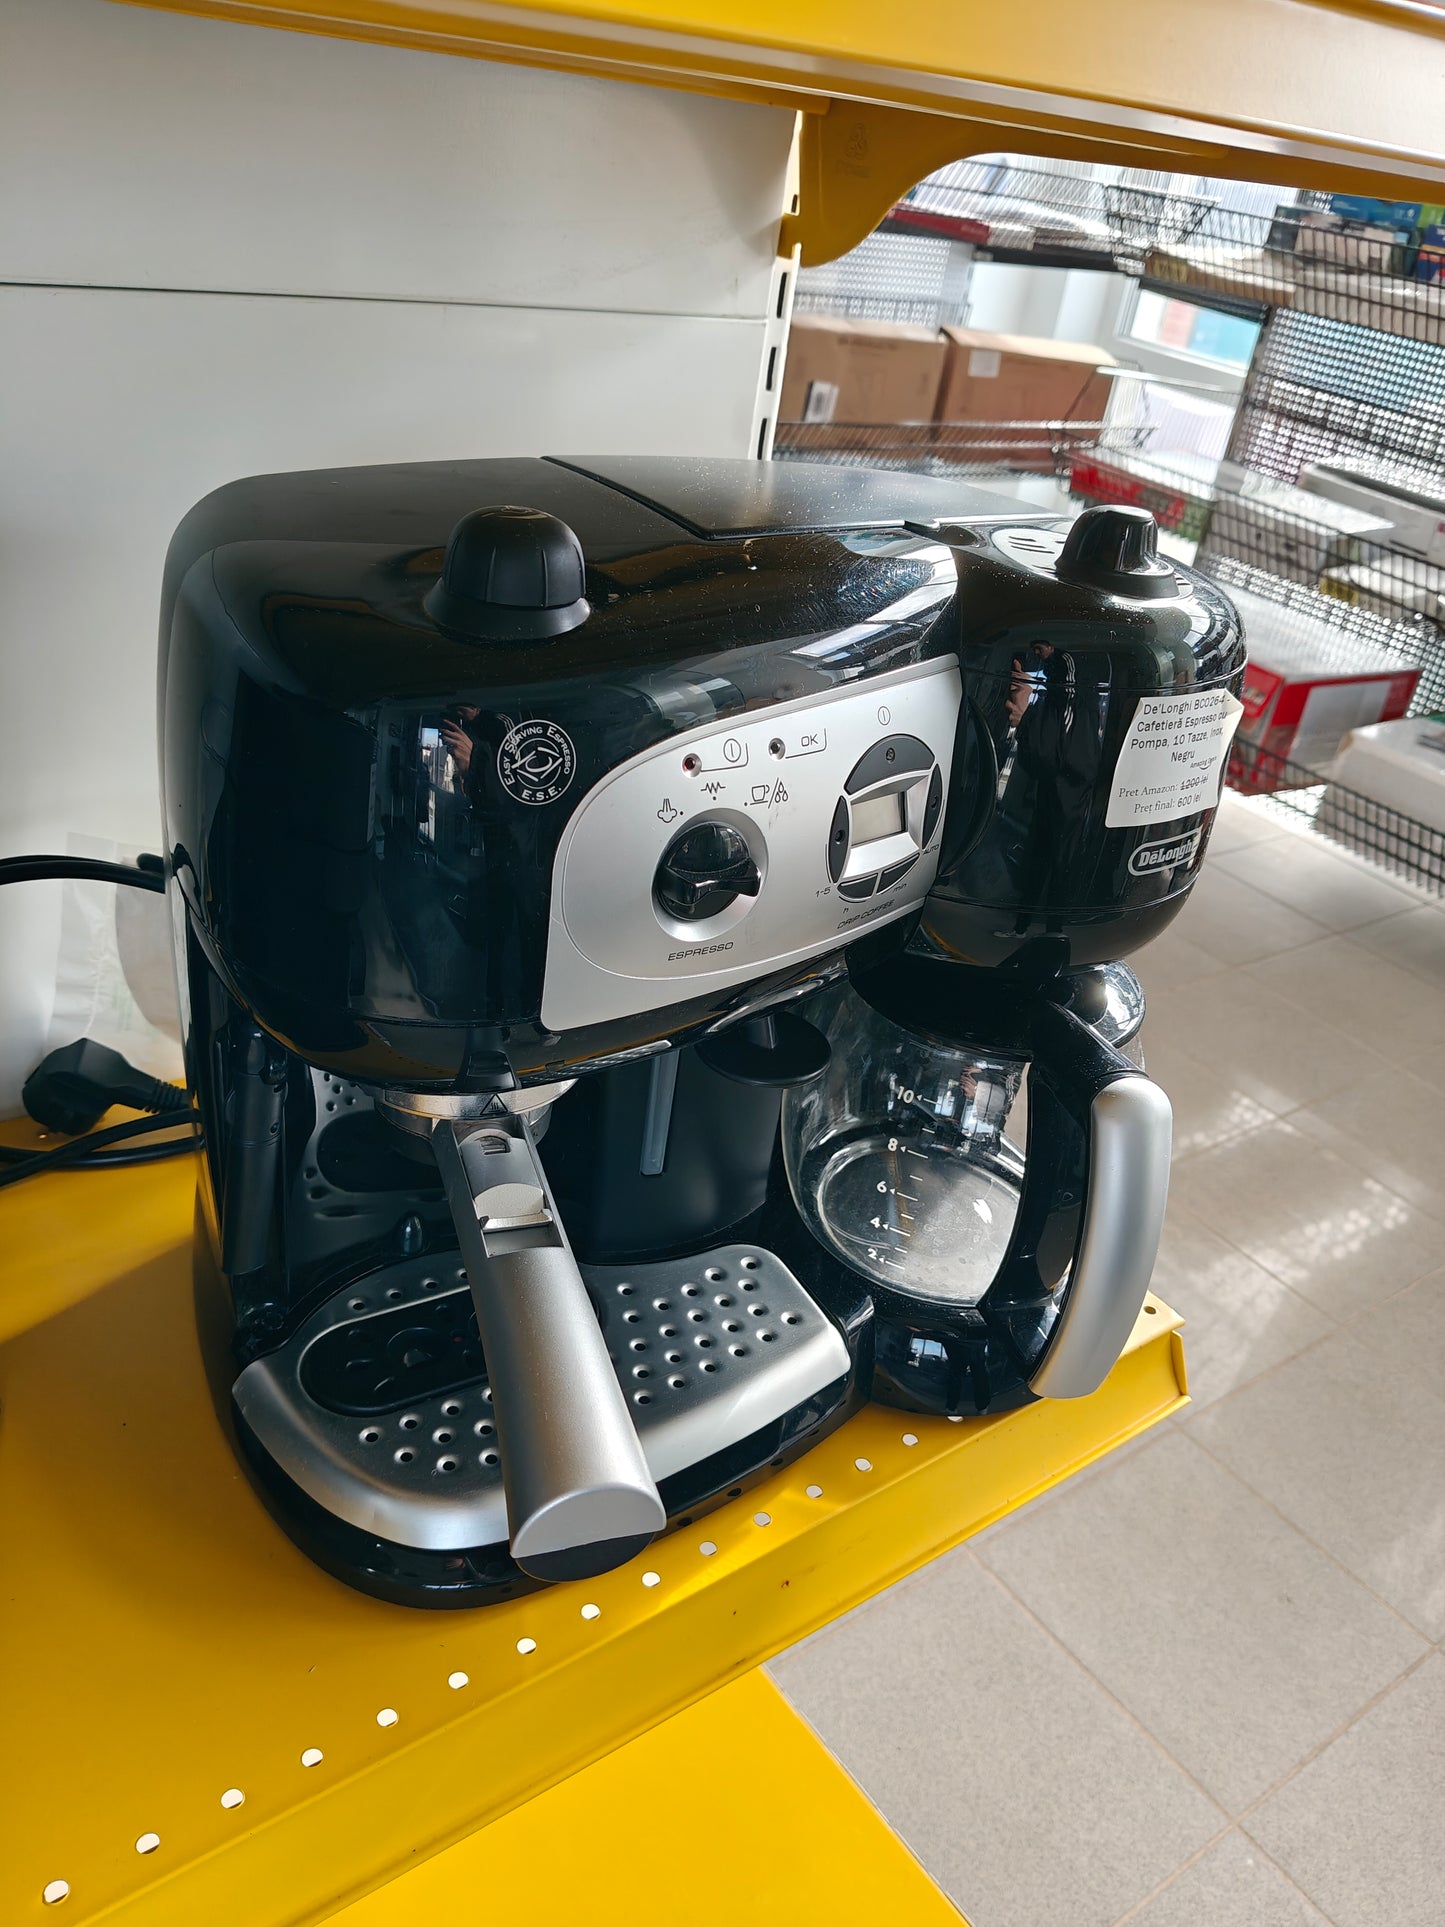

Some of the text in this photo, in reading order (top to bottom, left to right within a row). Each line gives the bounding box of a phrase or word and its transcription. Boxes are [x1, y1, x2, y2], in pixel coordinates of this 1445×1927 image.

[1114, 603, 1144, 613] STRONG
[1143, 700, 1193, 715] De'Longhi
[1137, 718, 1183, 732] Cafetieră
[1185, 713, 1217, 728] Espresso
[800, 733, 819, 747] OK
[1131, 738, 1170, 750] Pompa,
[1173, 734, 1185, 746] 10
[1187, 731, 1208, 744] Tazze,
[1170, 750, 1195, 763] Negru
[521, 785, 562, 801] E.S.E.
[1141, 784, 1178, 796] Amazon:
[1154, 798, 1175, 811] final:
[1177, 795, 1193, 808] 600
[861, 898, 896, 919] COFFEE
[667, 941, 734, 962] ESPRESSO
[897, 1086, 915, 1104] 10
[887, 1137, 898, 1152] 8
[876, 1181, 887, 1194] 6
[869, 1217, 880, 1229] 4
[867, 1248, 878, 1260] 2
